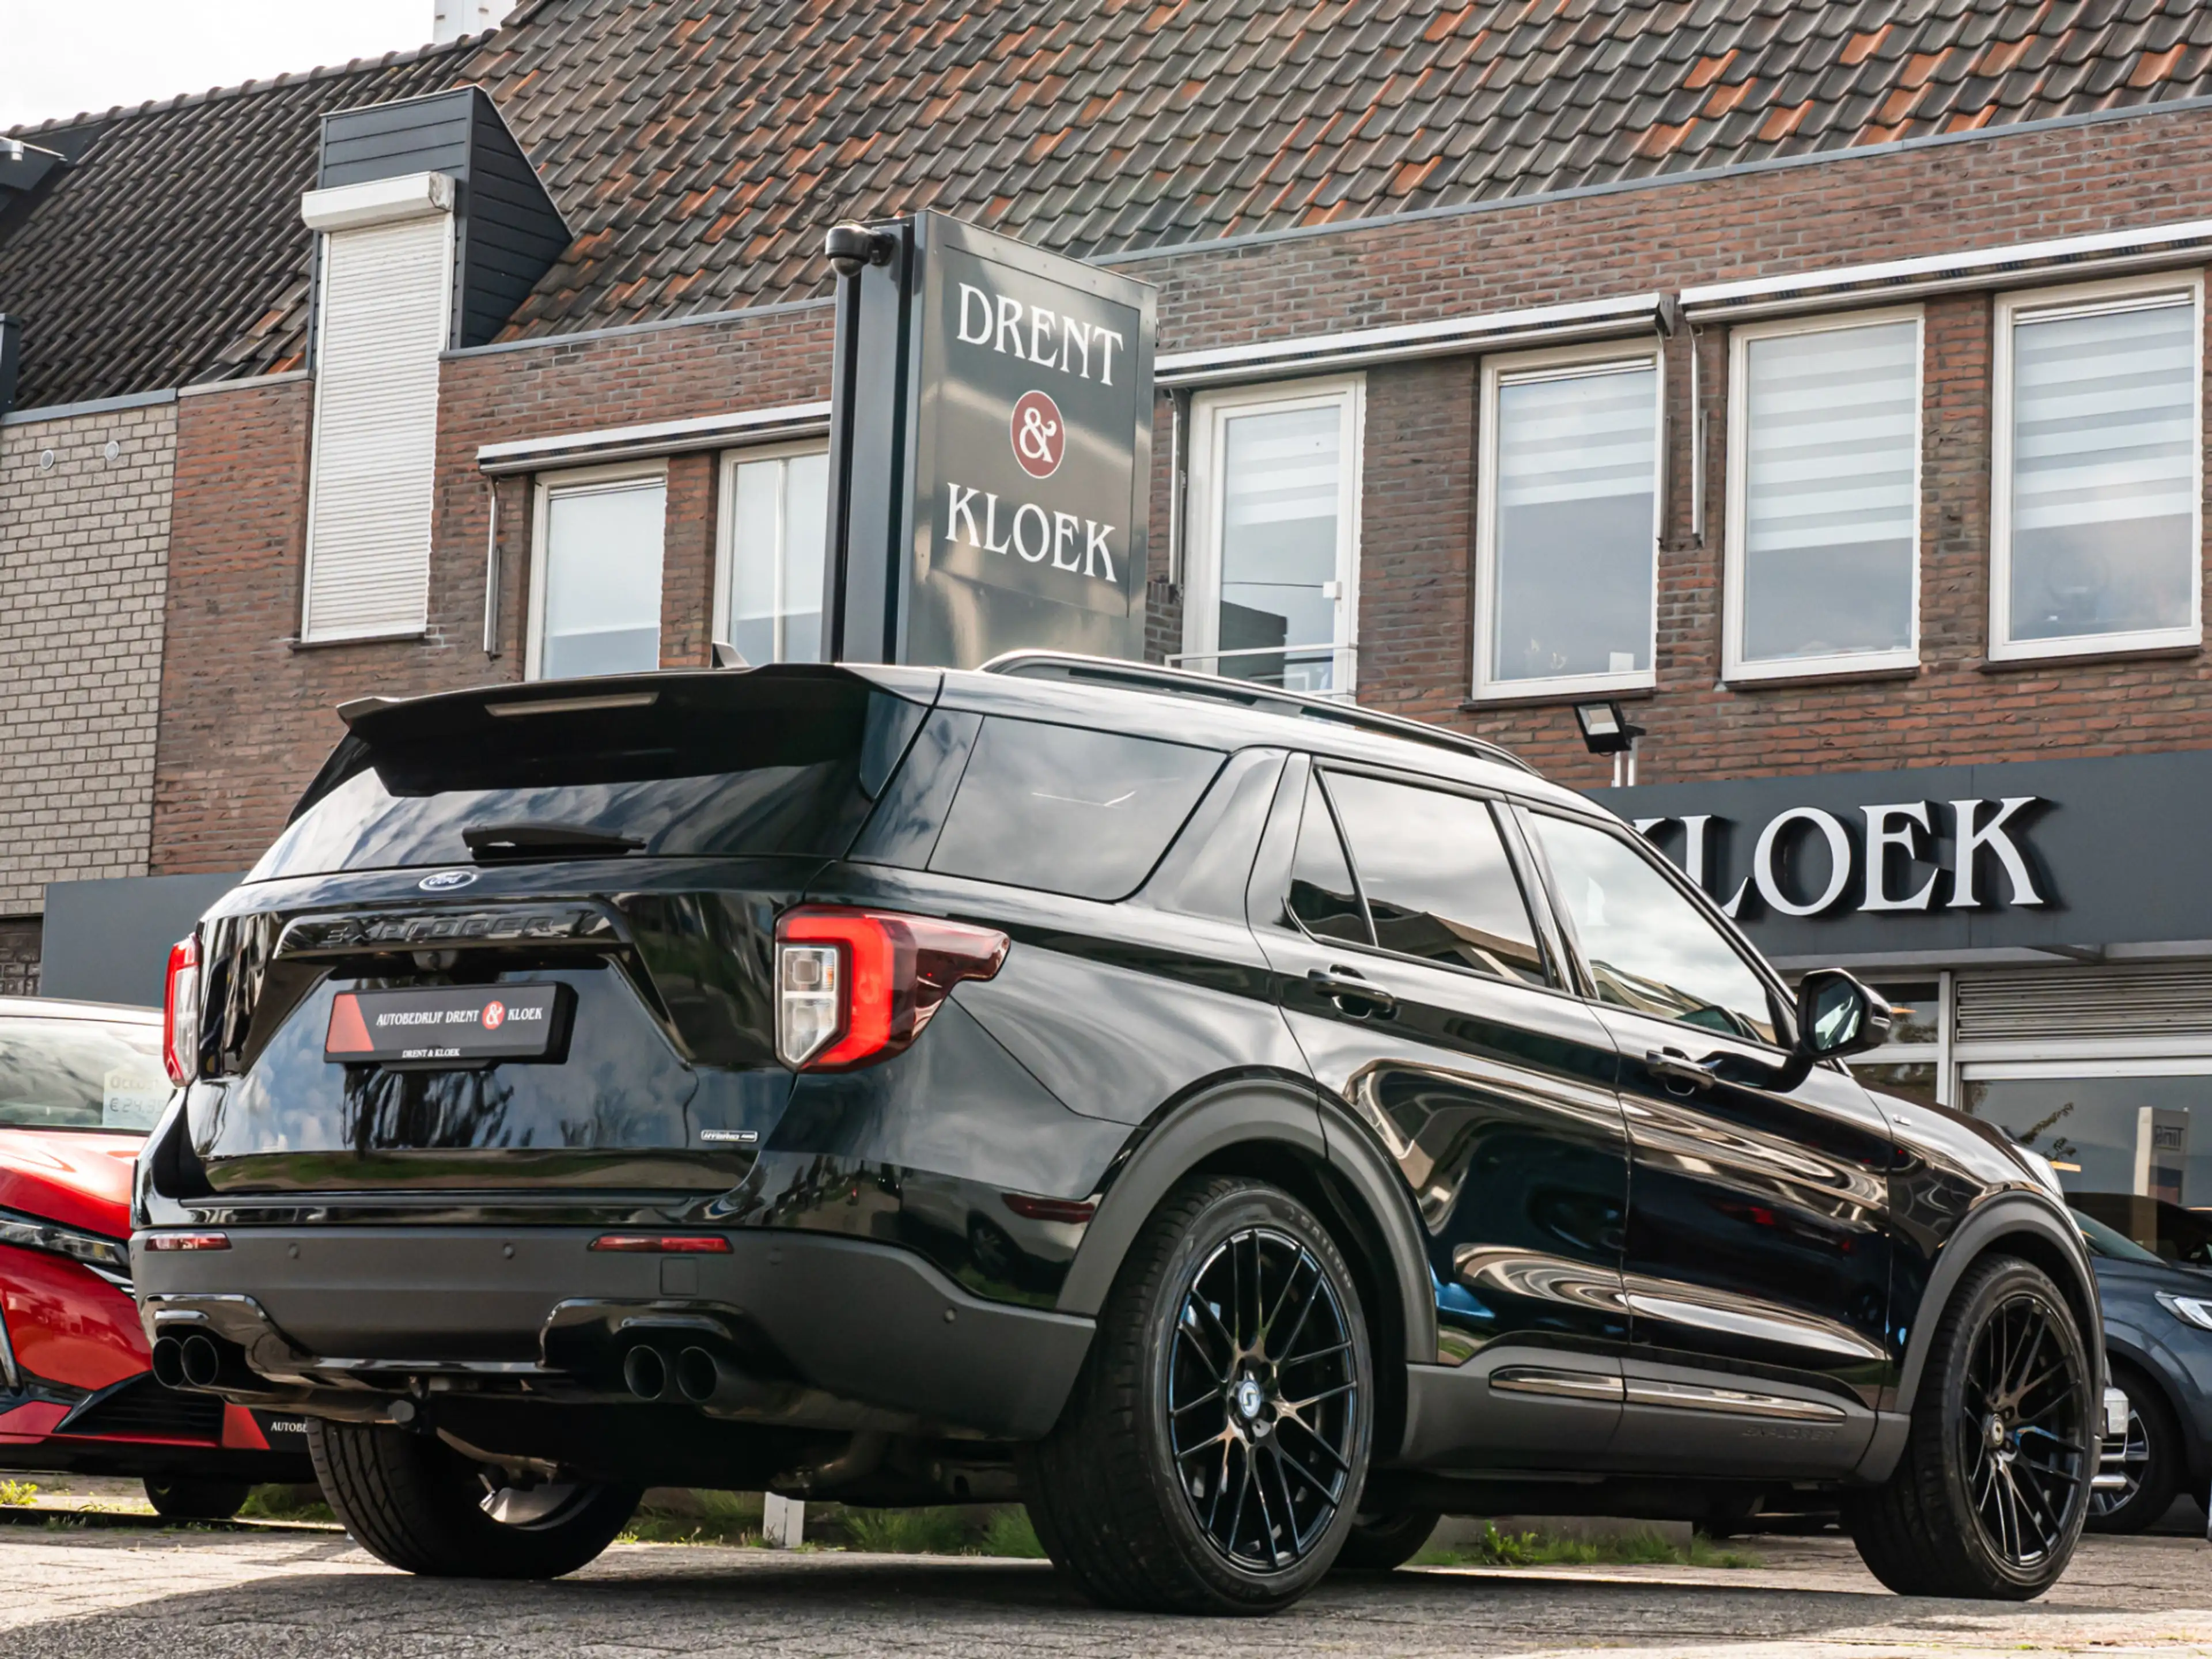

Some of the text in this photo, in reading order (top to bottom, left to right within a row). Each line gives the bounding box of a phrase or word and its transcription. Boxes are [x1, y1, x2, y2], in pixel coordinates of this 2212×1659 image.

[956, 282, 1123, 387] DRENT
[1018, 407, 1056, 464] &
[945, 482, 1118, 582] KLOEK
[376, 1003, 543, 1026] AUTOBEDRIJF DRENT & KLOEK
[402, 1050, 426, 1058] DRENT
[434, 1048, 460, 1056] KLOEK
